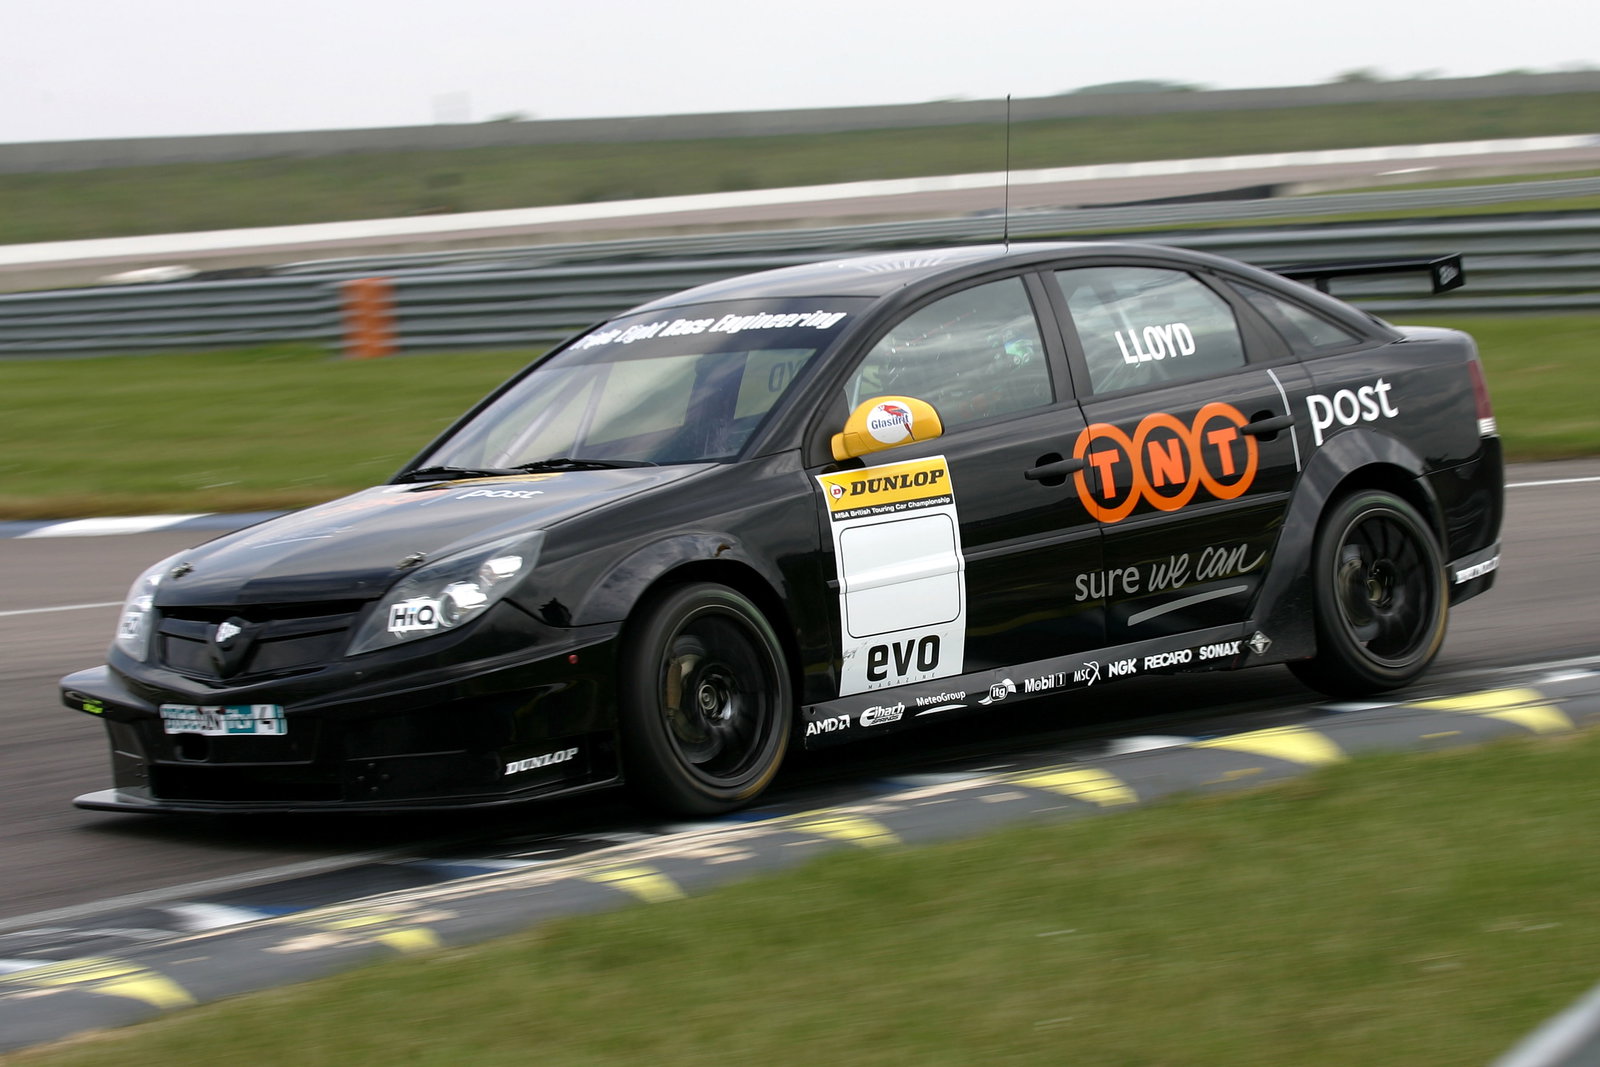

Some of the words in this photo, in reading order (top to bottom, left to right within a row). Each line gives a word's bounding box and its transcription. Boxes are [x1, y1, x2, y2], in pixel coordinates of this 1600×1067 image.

[614, 320, 669, 344] Eight
[659, 318, 715, 337] Race
[708, 310, 847, 334] Engineering
[1114, 322, 1196, 365] LLOYD
[1306, 377, 1399, 447] post
[1088, 426, 1240, 500] TNT
[850, 469, 944, 496] DUNLOP
[835, 511, 849, 519] MSA
[851, 508, 871, 517] British
[872, 504, 894, 513] Touring
[908, 495, 950, 507] Championship
[1074, 565, 1140, 601] sure
[1148, 552, 1190, 591] we
[1195, 543, 1266, 579] can
[391, 605, 434, 627] HiQ
[867, 634, 941, 683] evo
[1144, 649, 1193, 671] RECARO
[1199, 641, 1242, 661] SONAX
[1108, 658, 1137, 677] NGK
[868, 672, 936, 690] MAGAZINE
[992, 686, 1006, 698] itg
[1024, 674, 1054, 693] Mobil
[915, 690, 967, 707] MeteoGroup
[805, 717, 839, 736] AMD
[504, 747, 579, 775] DUNLOP
